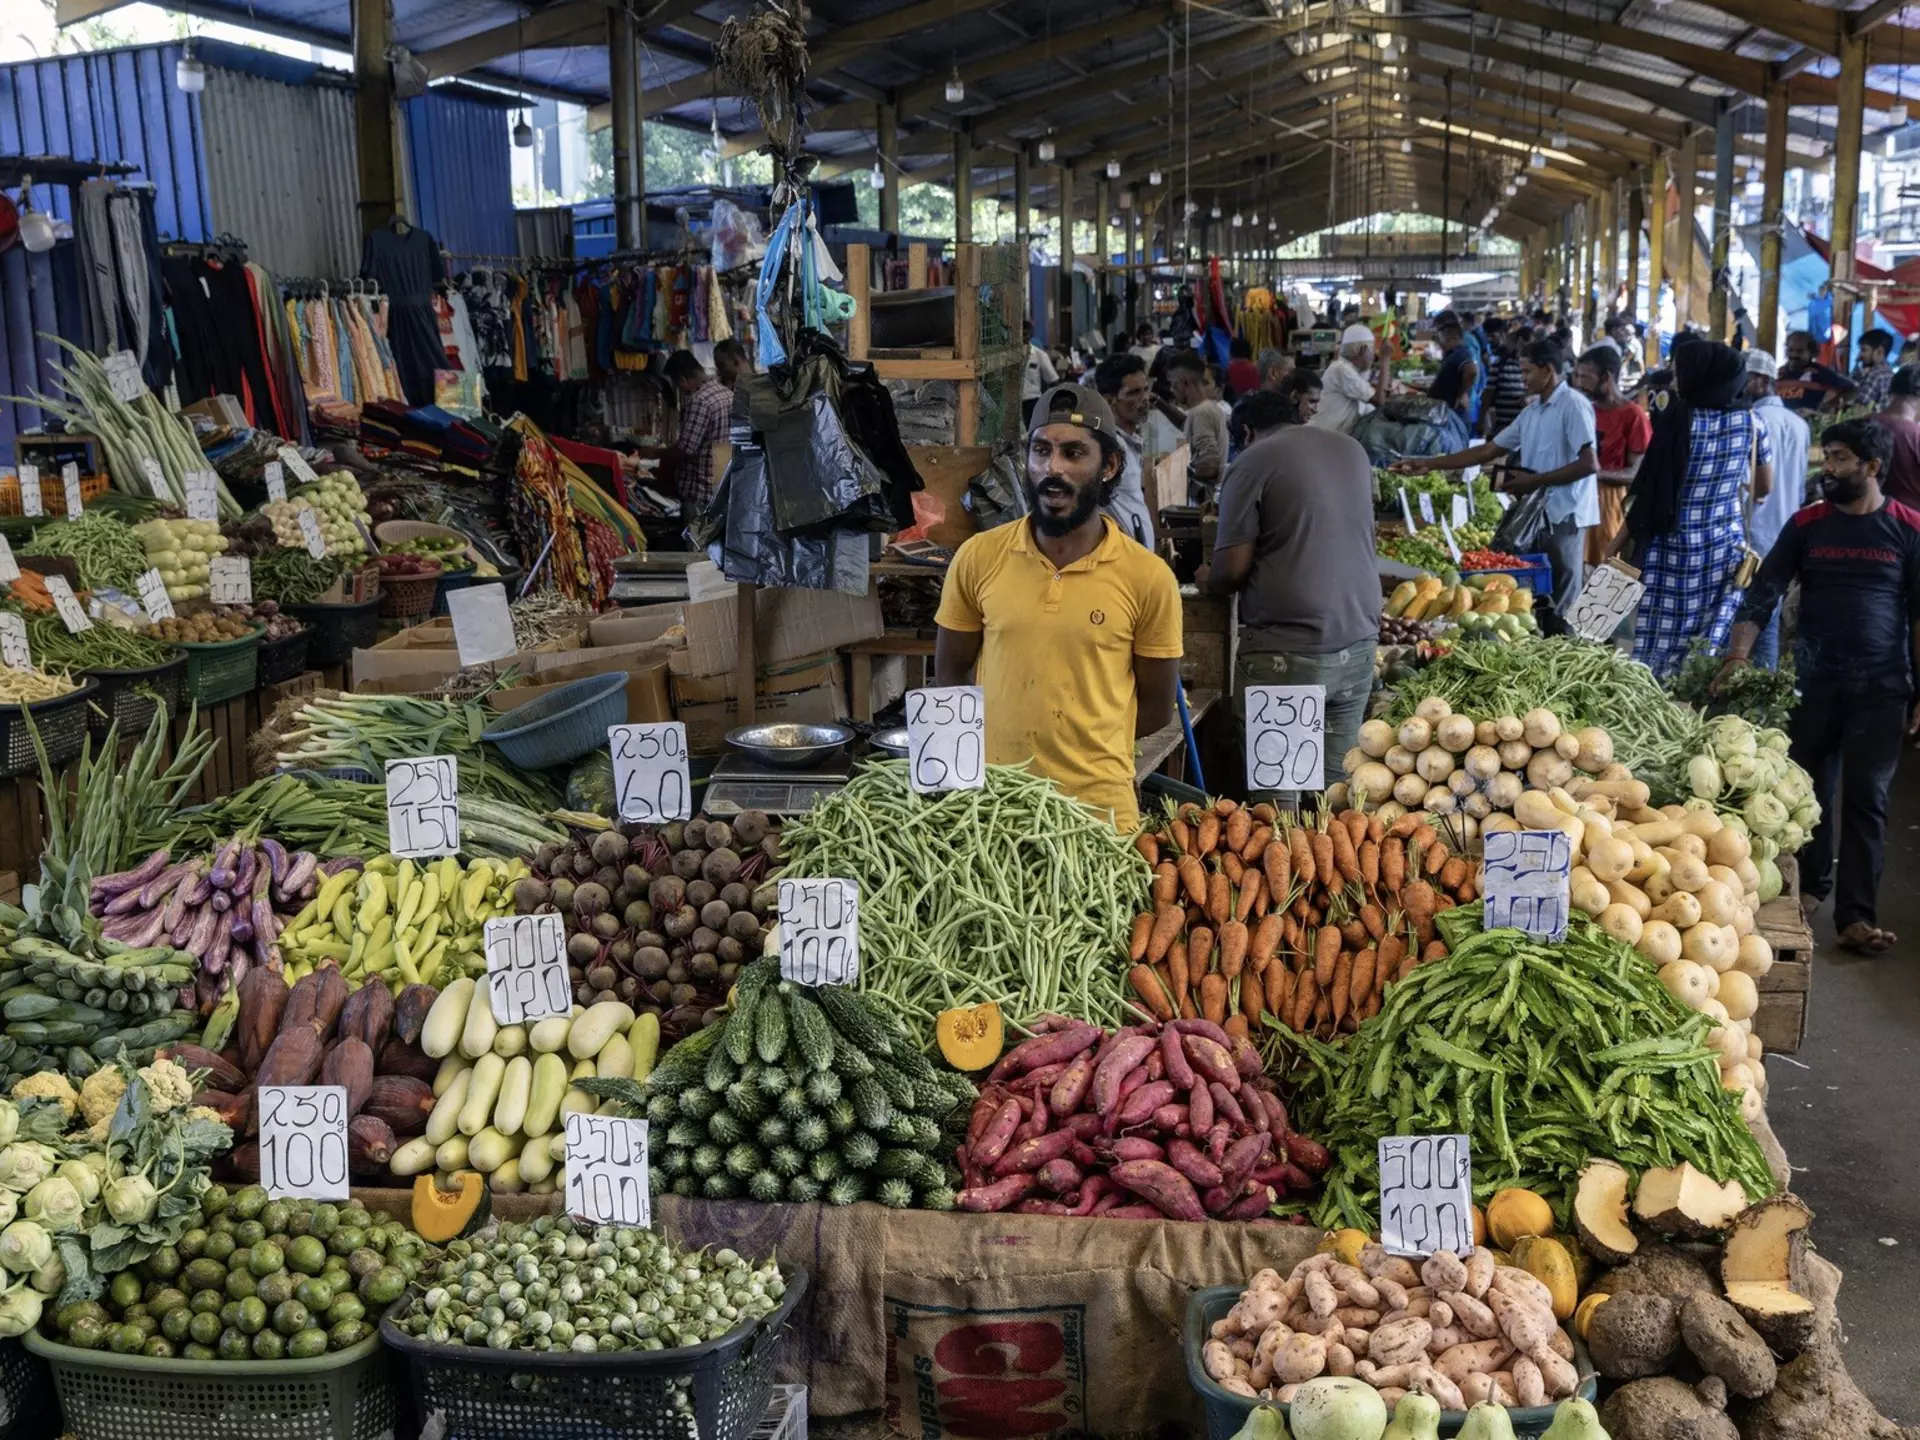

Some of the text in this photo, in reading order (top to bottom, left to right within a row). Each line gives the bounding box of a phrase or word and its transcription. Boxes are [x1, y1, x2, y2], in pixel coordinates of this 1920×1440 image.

[916, 731, 980, 787] 60
[1253, 729, 1318, 787] 80
[621, 769, 684, 820] 60
[397, 805, 457, 852] 150
[263, 1132, 345, 1190] 100
